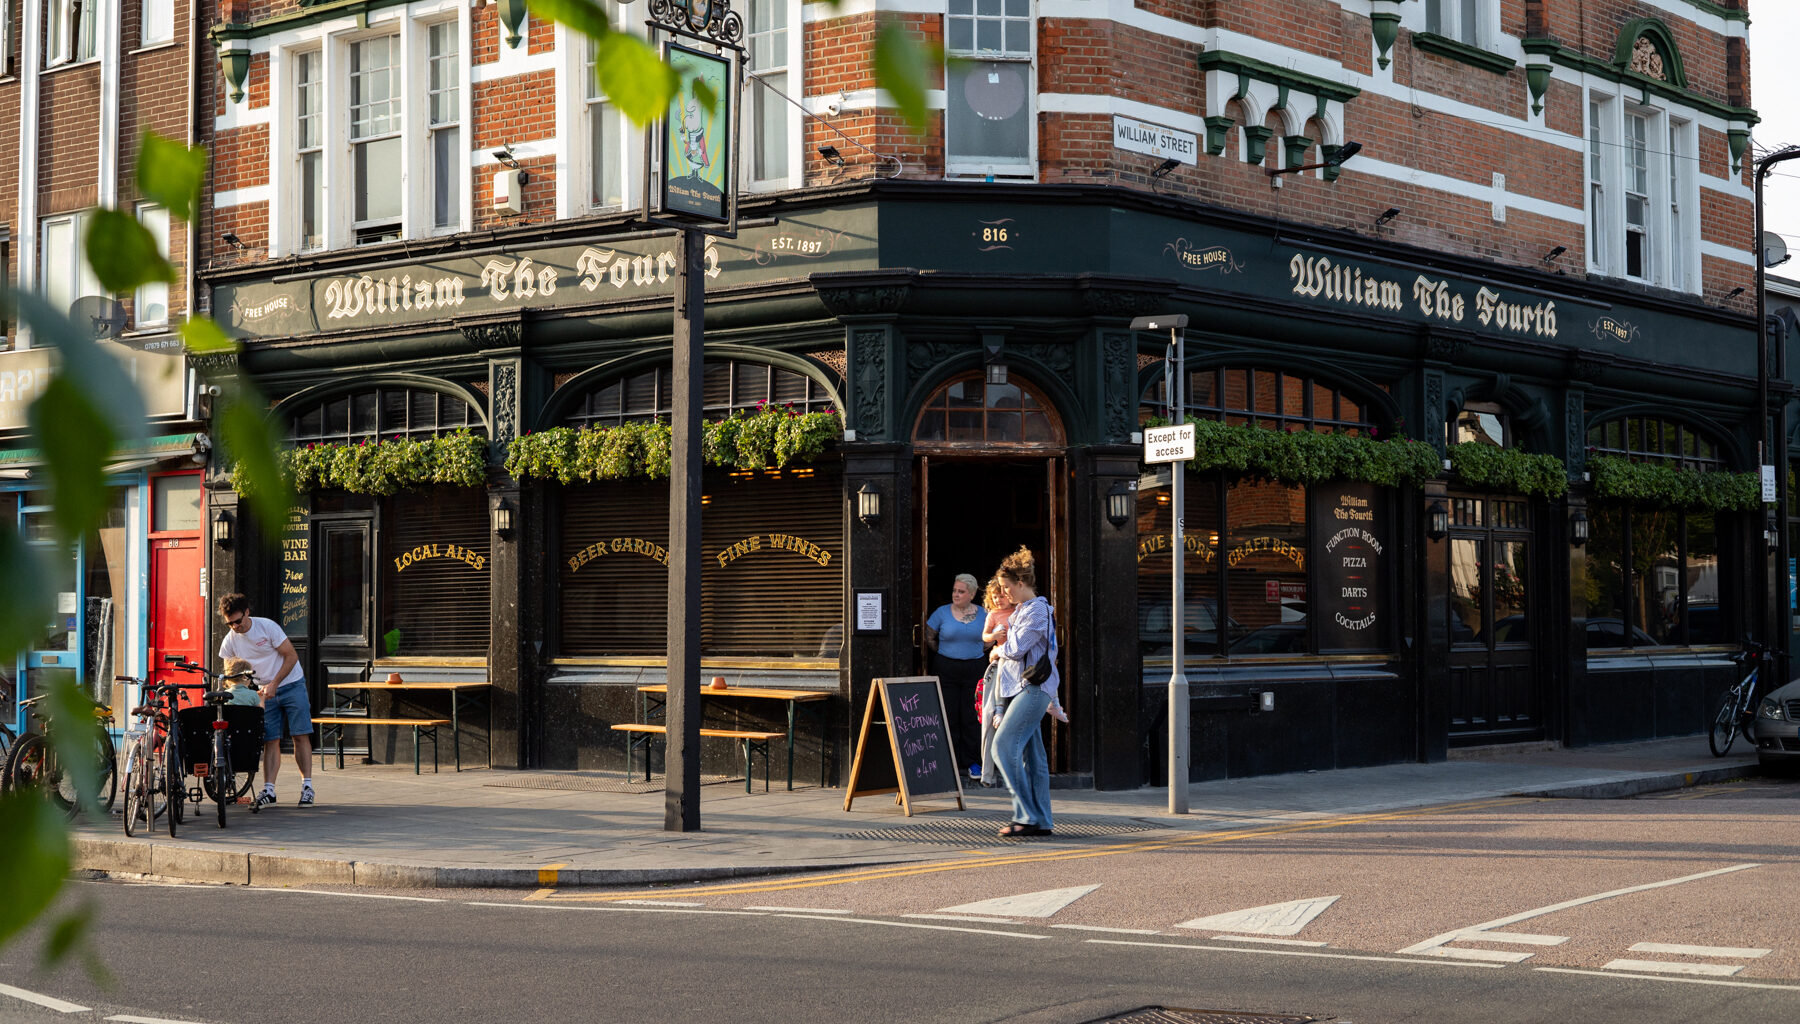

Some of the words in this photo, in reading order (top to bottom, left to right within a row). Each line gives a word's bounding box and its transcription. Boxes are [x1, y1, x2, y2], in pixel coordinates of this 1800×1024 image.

[1118, 124, 1156, 146] WILLIAM
[1161, 135, 1194, 154] STREET
[983, 228, 1008, 242] 816
[772, 237, 794, 250] EST.
[797, 239, 822, 253] 1897
[1183, 251, 1201, 265] FREE
[1203, 250, 1226, 264] HOUSE
[325, 274, 466, 319] William
[481, 256, 558, 301] The
[576, 236, 722, 292] Fourh
[1290, 253, 1403, 311] William
[1412, 274, 1465, 321] The
[1476, 286, 1558, 338] Fourth
[244, 304, 263, 318] FREE
[264, 297, 288, 313] HOUSE
[1148, 430, 1176, 443] Except
[1179, 430, 1191, 440] for
[1155, 447, 1184, 457] access
[1340, 495, 1368, 507] William
[1333, 507, 1348, 521] The
[1348, 508, 1373, 521] Fourth
[282, 538, 309, 549] WINE
[716, 536, 761, 568] FINE
[768, 533, 832, 567] WINES
[1137, 534, 1166, 564] LIVE
[1325, 527, 1360, 553] FUNCTION
[1361, 530, 1383, 555] ROOM
[284, 550, 308, 561] BAR
[394, 543, 441, 573] LOCAL
[444, 544, 486, 571] ALES
[568, 541, 609, 573] BEER
[1228, 536, 1270, 567] CRAFT
[1272, 537, 1304, 570] BEER
[1342, 556, 1367, 568] PIZZA
[284, 568, 304, 581] Free
[282, 583, 308, 594] House
[1341, 587, 1368, 598] DARTS
[1335, 611, 1376, 630] COCKTAILS
[899, 693, 920, 712] WTF
[894, 714, 940, 735] RE-OPENING
[903, 738, 924, 757] JUNE
